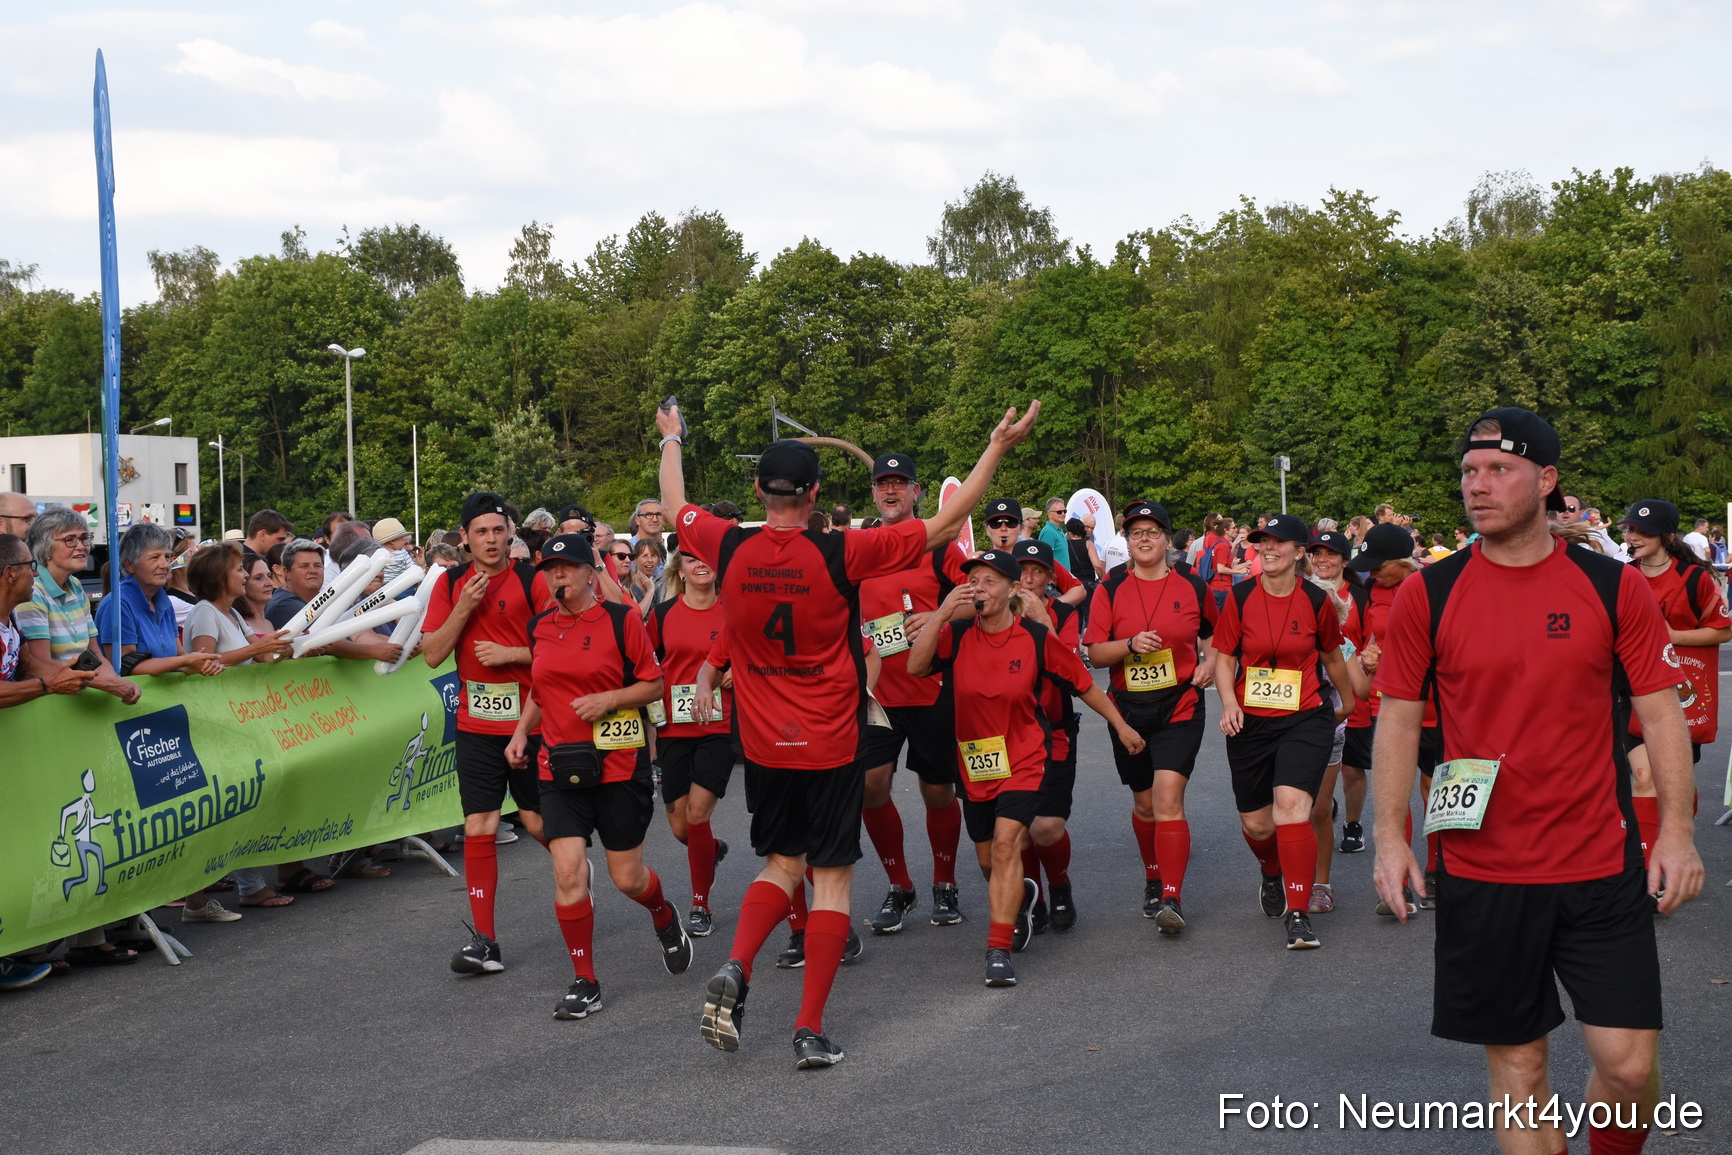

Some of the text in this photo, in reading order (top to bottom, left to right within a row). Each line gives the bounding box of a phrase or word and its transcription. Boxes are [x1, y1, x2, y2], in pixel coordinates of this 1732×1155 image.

[747, 567, 804, 579] TRENDHAUS
[741, 583, 811, 595] POWER-TEAM
[311, 586, 336, 611] UMS
[361, 591, 386, 613] UMS
[498, 600, 506, 610] 9
[1173, 601, 1180, 610] 8
[762, 602, 796, 656] 4
[1291, 620, 1299, 631] 3
[1547, 613, 1571, 632] 23
[583, 636, 591, 646] 3
[1009, 659, 1021, 671] 24
[1129, 663, 1168, 681] 2331
[1251, 681, 1293, 699] 2348
[229, 677, 334, 724] Gesunde Firmen
[449, 695, 459, 708] Fis
[473, 694, 512, 711] 2350
[271, 696, 367, 751] laufen länger!
[600, 719, 640, 737] 2329
[137, 736, 181, 760] Fischer
[147, 751, 182, 768] AUTOMOBILE
[419, 743, 457, 786] firm
[968, 752, 1000, 770] 2357
[416, 775, 456, 803] neumarkt
[1430, 783, 1479, 814] 2336
[113, 759, 265, 862] firmenlauf
[1446, 809, 1466, 817] Markus
[118, 841, 186, 884] neumarkt
